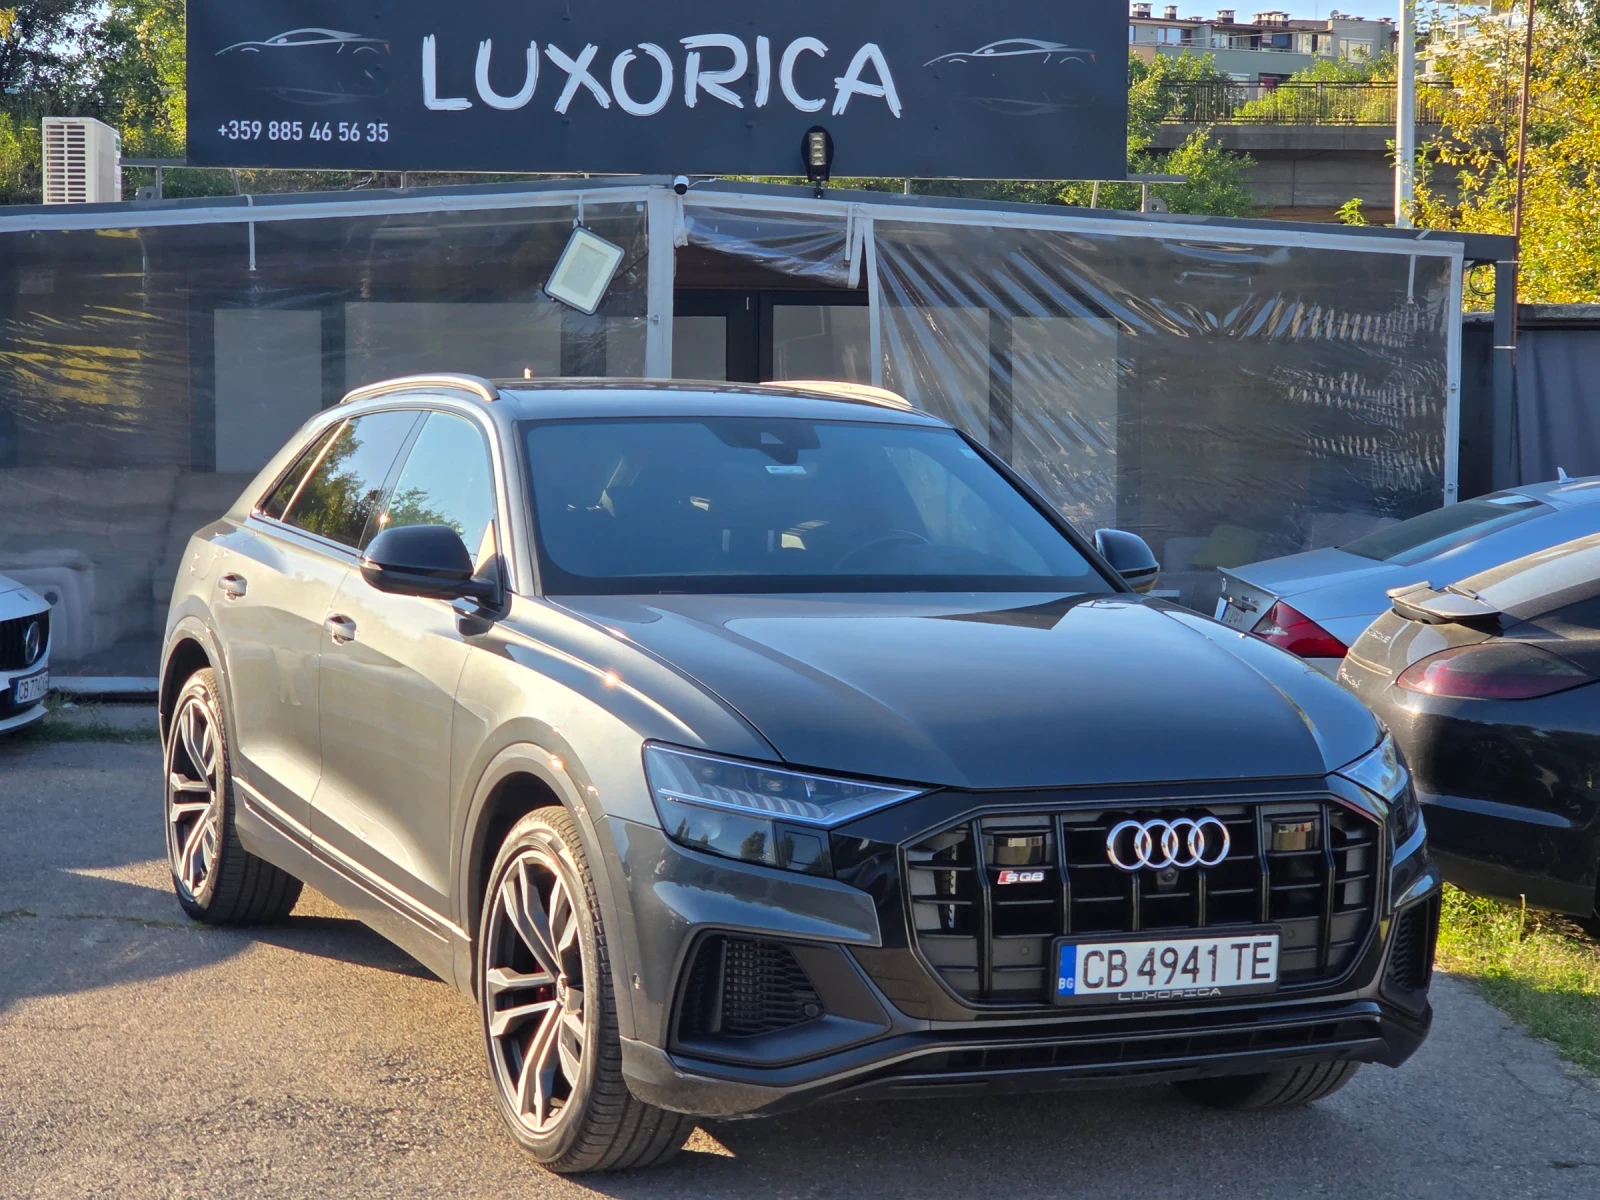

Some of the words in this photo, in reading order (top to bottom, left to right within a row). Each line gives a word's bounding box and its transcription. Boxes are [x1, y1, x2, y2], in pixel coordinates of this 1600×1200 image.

[422, 34, 903, 118] LUXORICA
[218, 120, 262, 140] +359
[268, 121, 303, 141] 885
[309, 121, 332, 141] 46
[338, 122, 360, 142] 56
[366, 122, 389, 142] 35
[997, 870, 1044, 884] SQ8
[1082, 949, 1128, 989] CB
[1137, 944, 1218, 986] 4941
[1230, 941, 1273, 981] TE
[1058, 977, 1074, 990] BG
[1117, 987, 1222, 1001] LUXORICA
